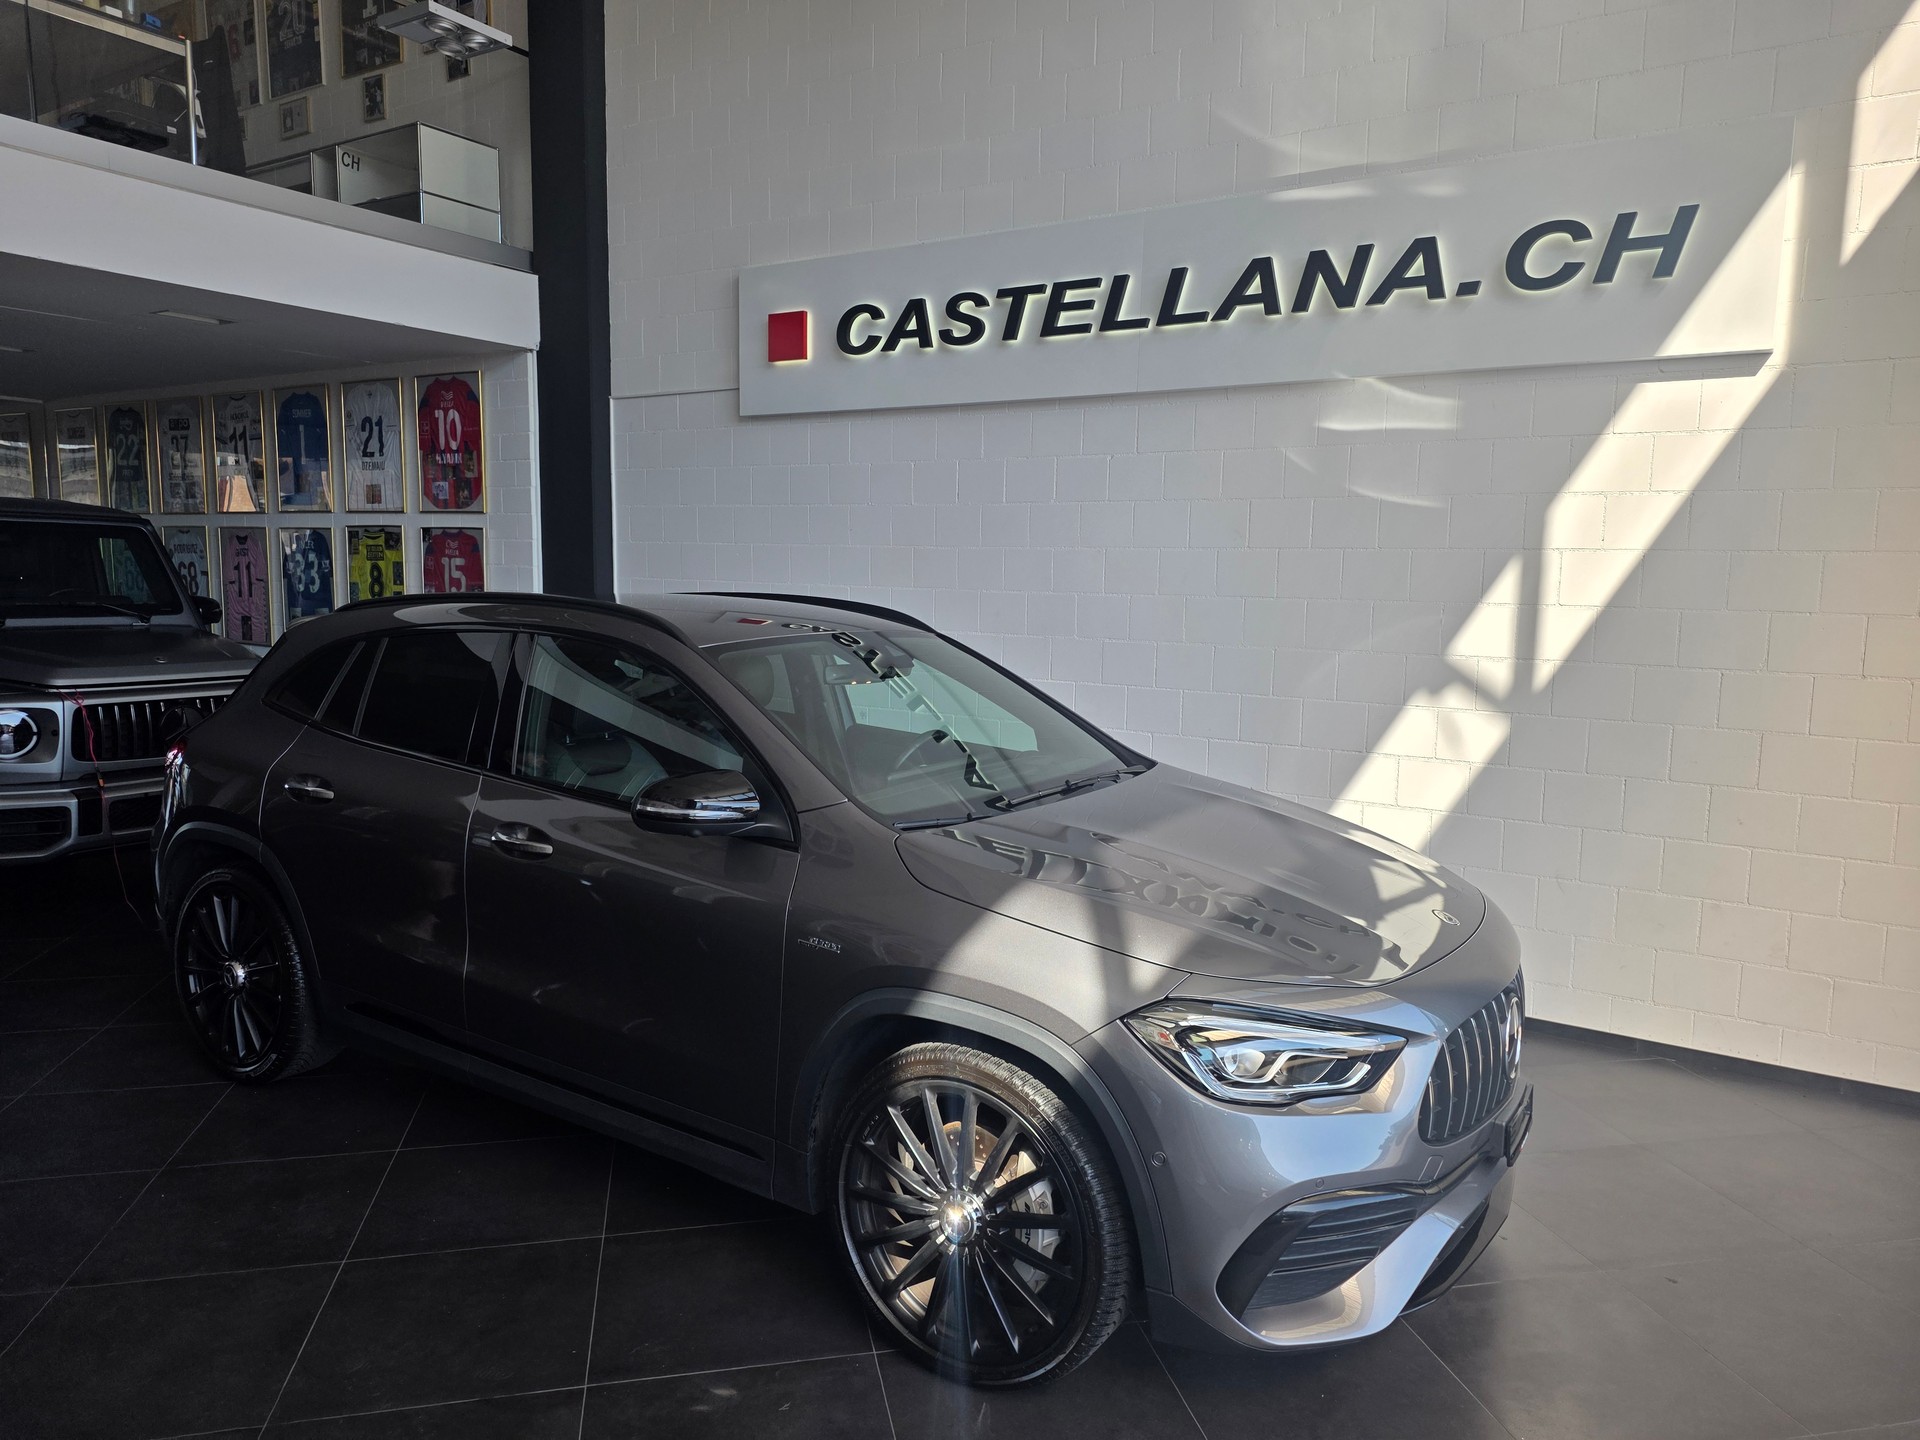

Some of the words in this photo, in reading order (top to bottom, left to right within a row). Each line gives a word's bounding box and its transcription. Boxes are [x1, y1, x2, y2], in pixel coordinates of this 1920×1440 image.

[341, 151, 361, 172] CH
[836, 203, 1701, 356] CASTELLANA.CH
[229, 425, 250, 468] 11
[299, 424, 306, 465] 1
[361, 415, 385, 458] 21
[434, 408, 462, 451] 10
[116, 433, 139, 466] 22
[178, 561, 199, 595] 68
[234, 561, 252, 598] 11
[294, 552, 320, 593] 33
[369, 562, 384, 599] 8
[441, 556, 467, 592] 15
